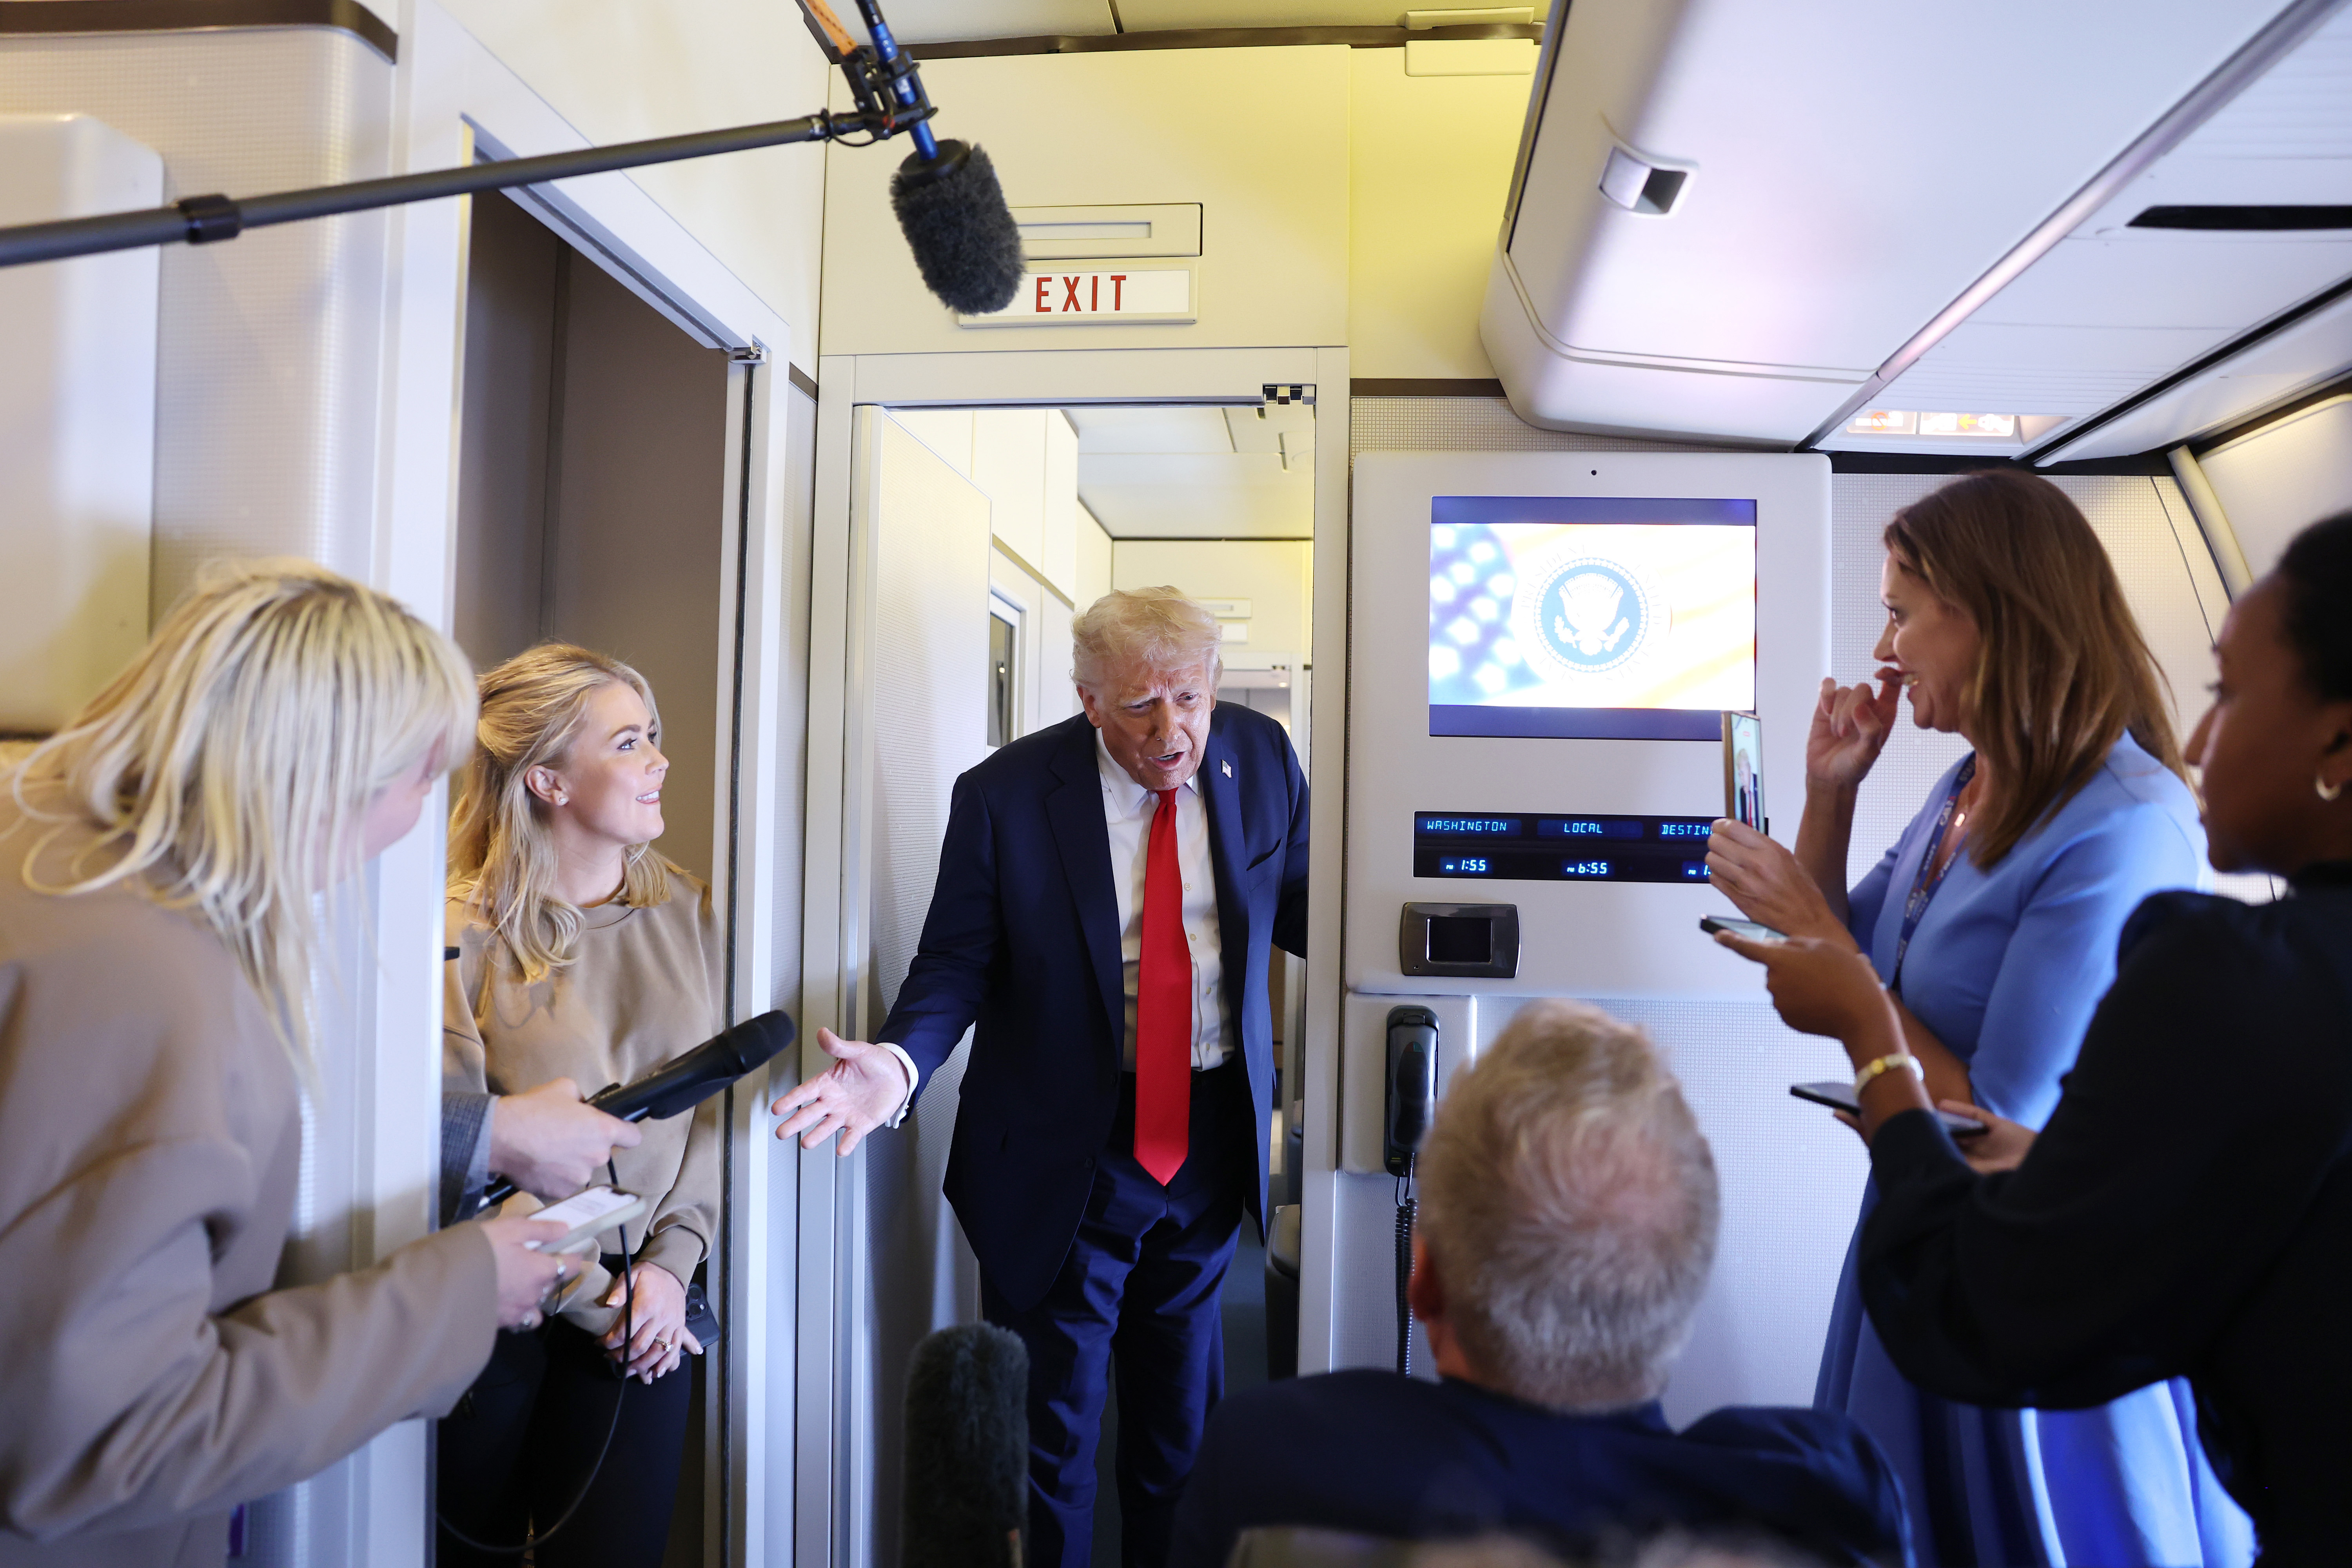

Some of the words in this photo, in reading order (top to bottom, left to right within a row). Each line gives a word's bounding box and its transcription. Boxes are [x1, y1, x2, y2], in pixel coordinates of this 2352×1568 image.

[1036, 275, 1126, 312] EXIT
[1427, 820, 1506, 831] WASHINGTON
[1564, 823, 1602, 833] LOCAL
[1461, 859, 1486, 871] 1:55
[1578, 862, 1607, 874] 6:55
